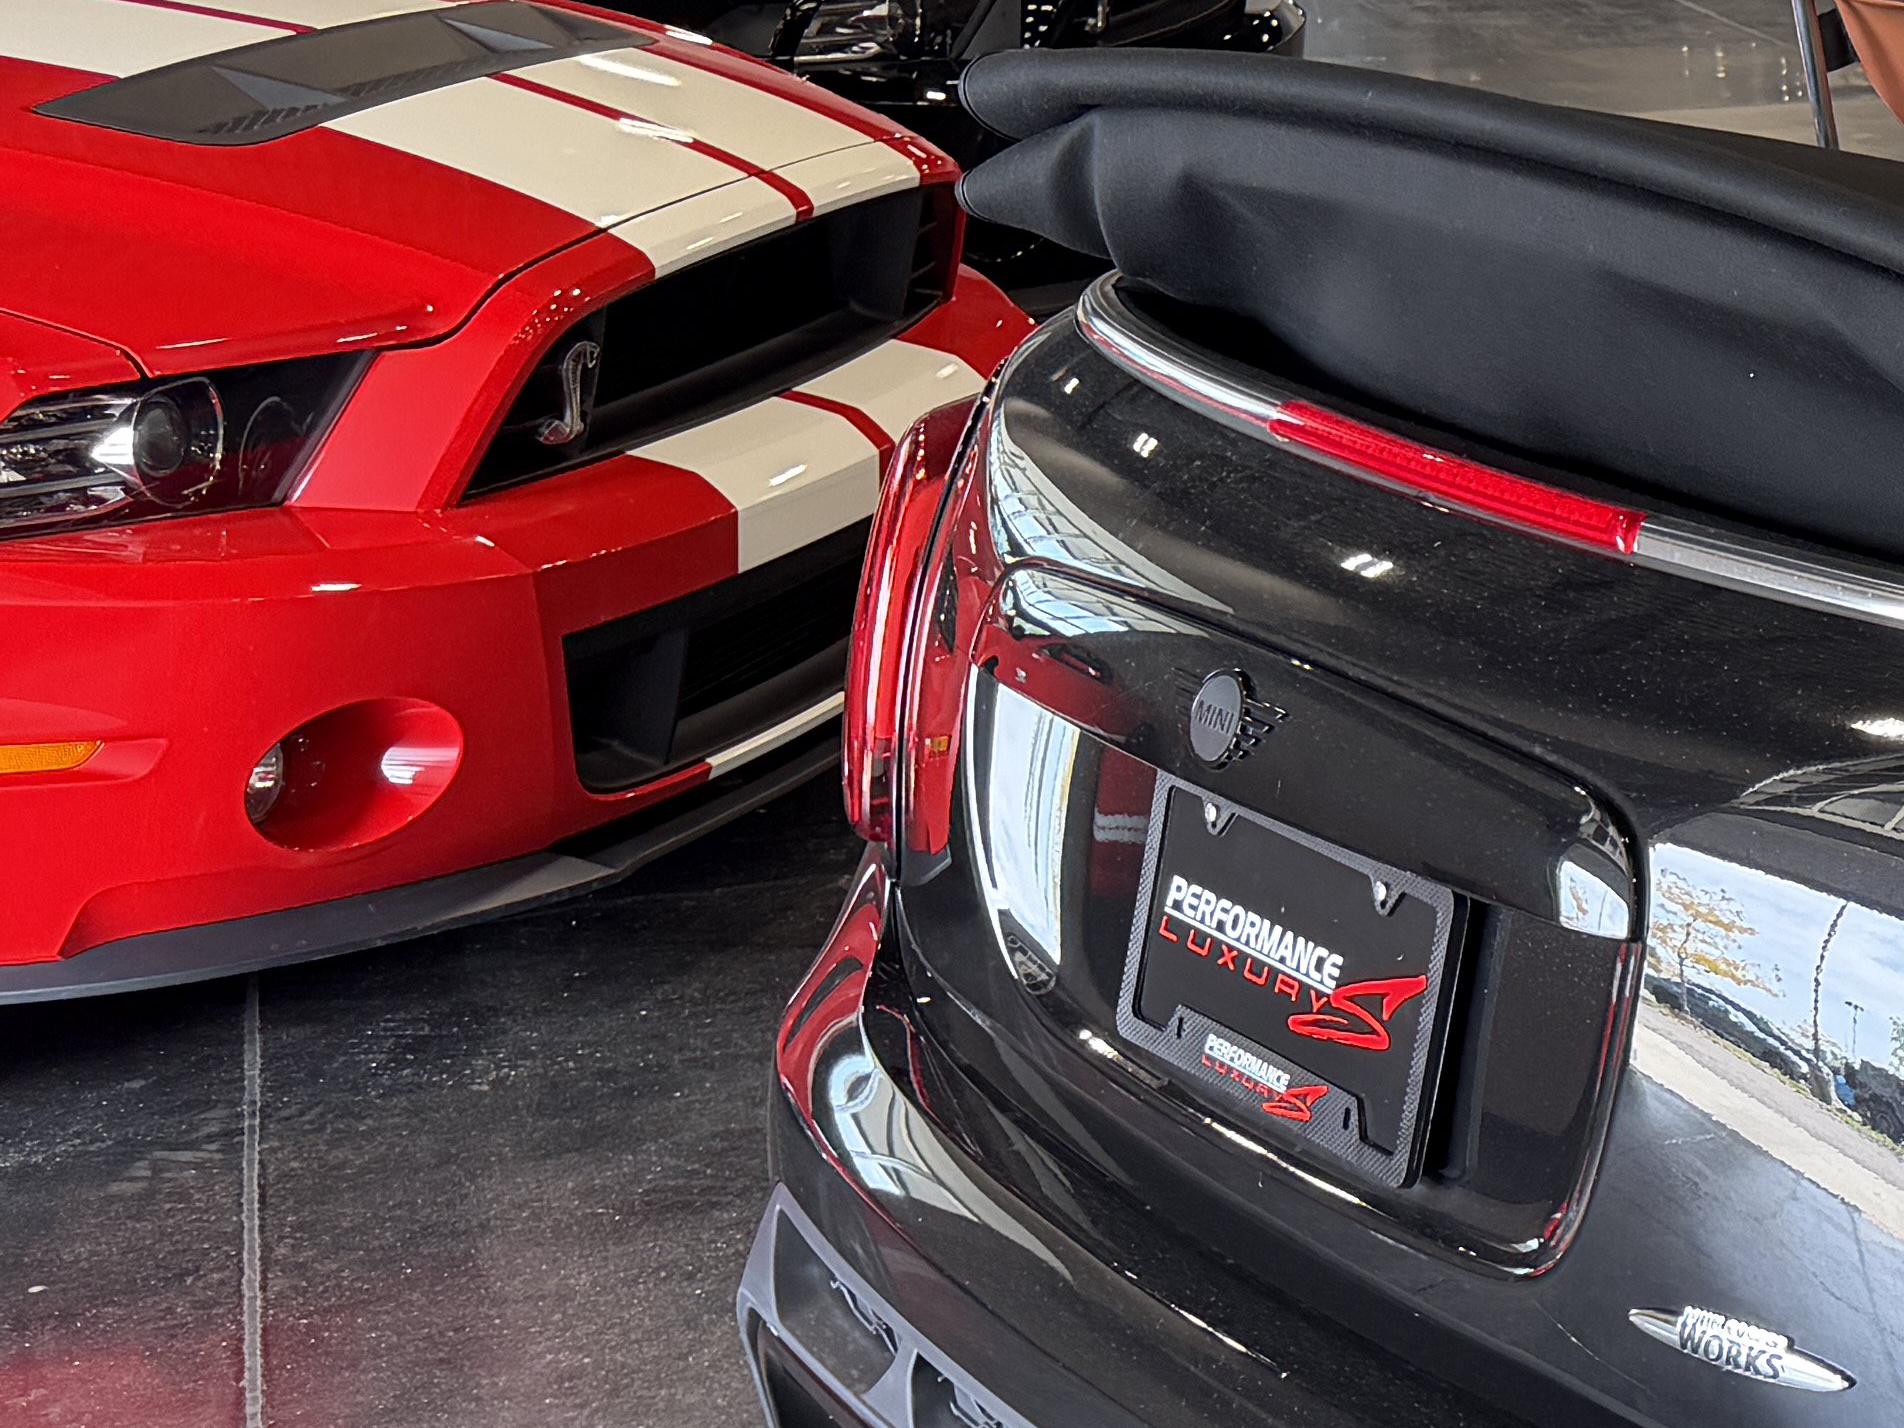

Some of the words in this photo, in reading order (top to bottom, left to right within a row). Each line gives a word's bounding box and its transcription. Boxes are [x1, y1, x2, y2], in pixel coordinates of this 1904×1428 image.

[1195, 700, 1235, 734] MINI
[1165, 875, 1344, 988] PERFORMANCE
[1204, 1033, 1290, 1090] PERFORMANCE
[1679, 1317, 1784, 1380] WORKS
